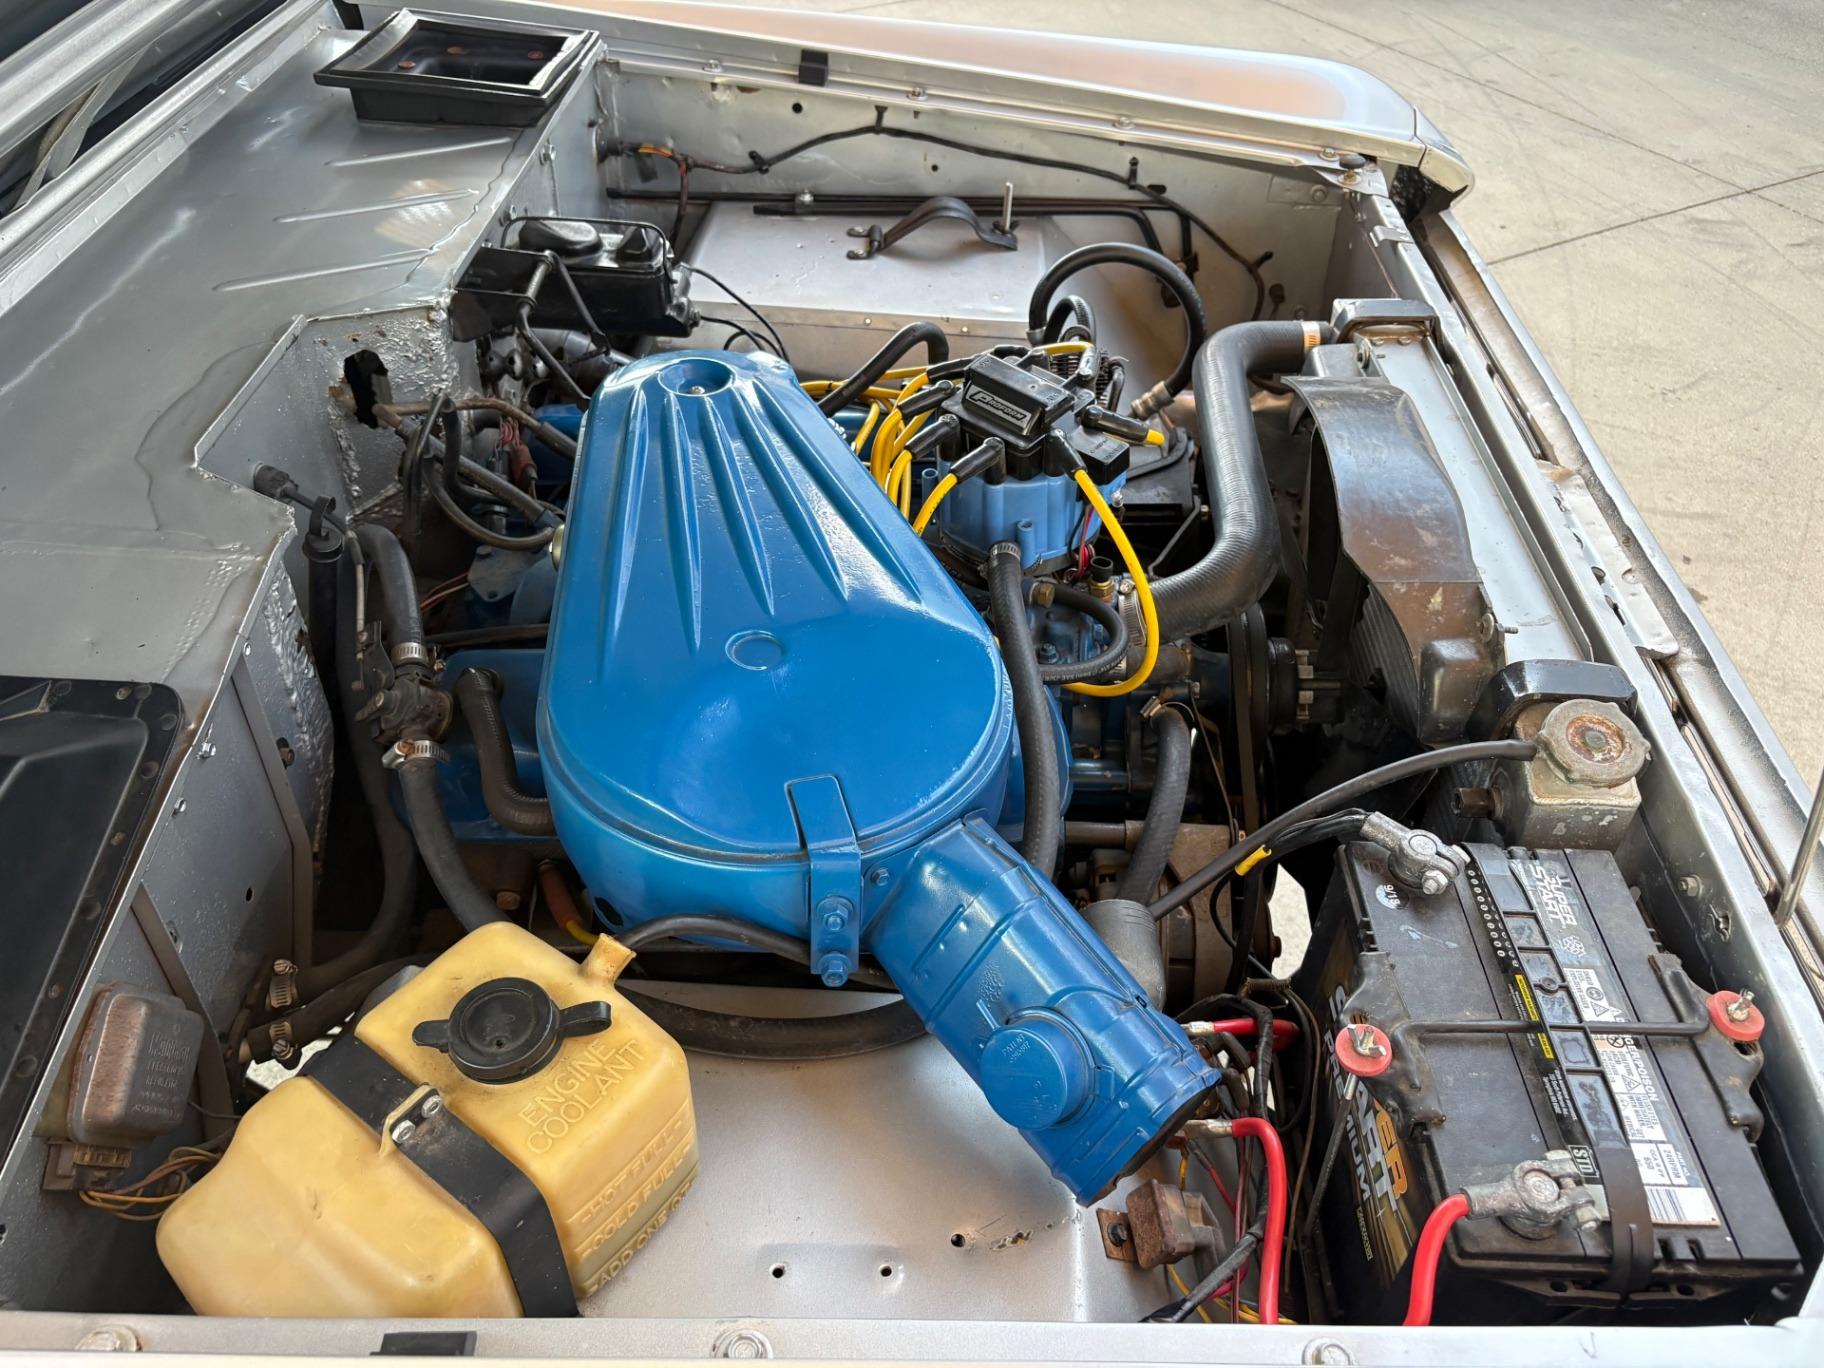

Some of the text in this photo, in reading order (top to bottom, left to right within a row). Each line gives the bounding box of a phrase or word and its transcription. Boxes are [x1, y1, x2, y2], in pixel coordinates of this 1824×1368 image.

[969, 390, 1027, 421] PROFORM
[1528, 863, 1567, 929] START
[518, 1037, 617, 1127] ENGINE
[526, 1039, 645, 1155] COOLANT
[1572, 1148, 1595, 1174] STD
